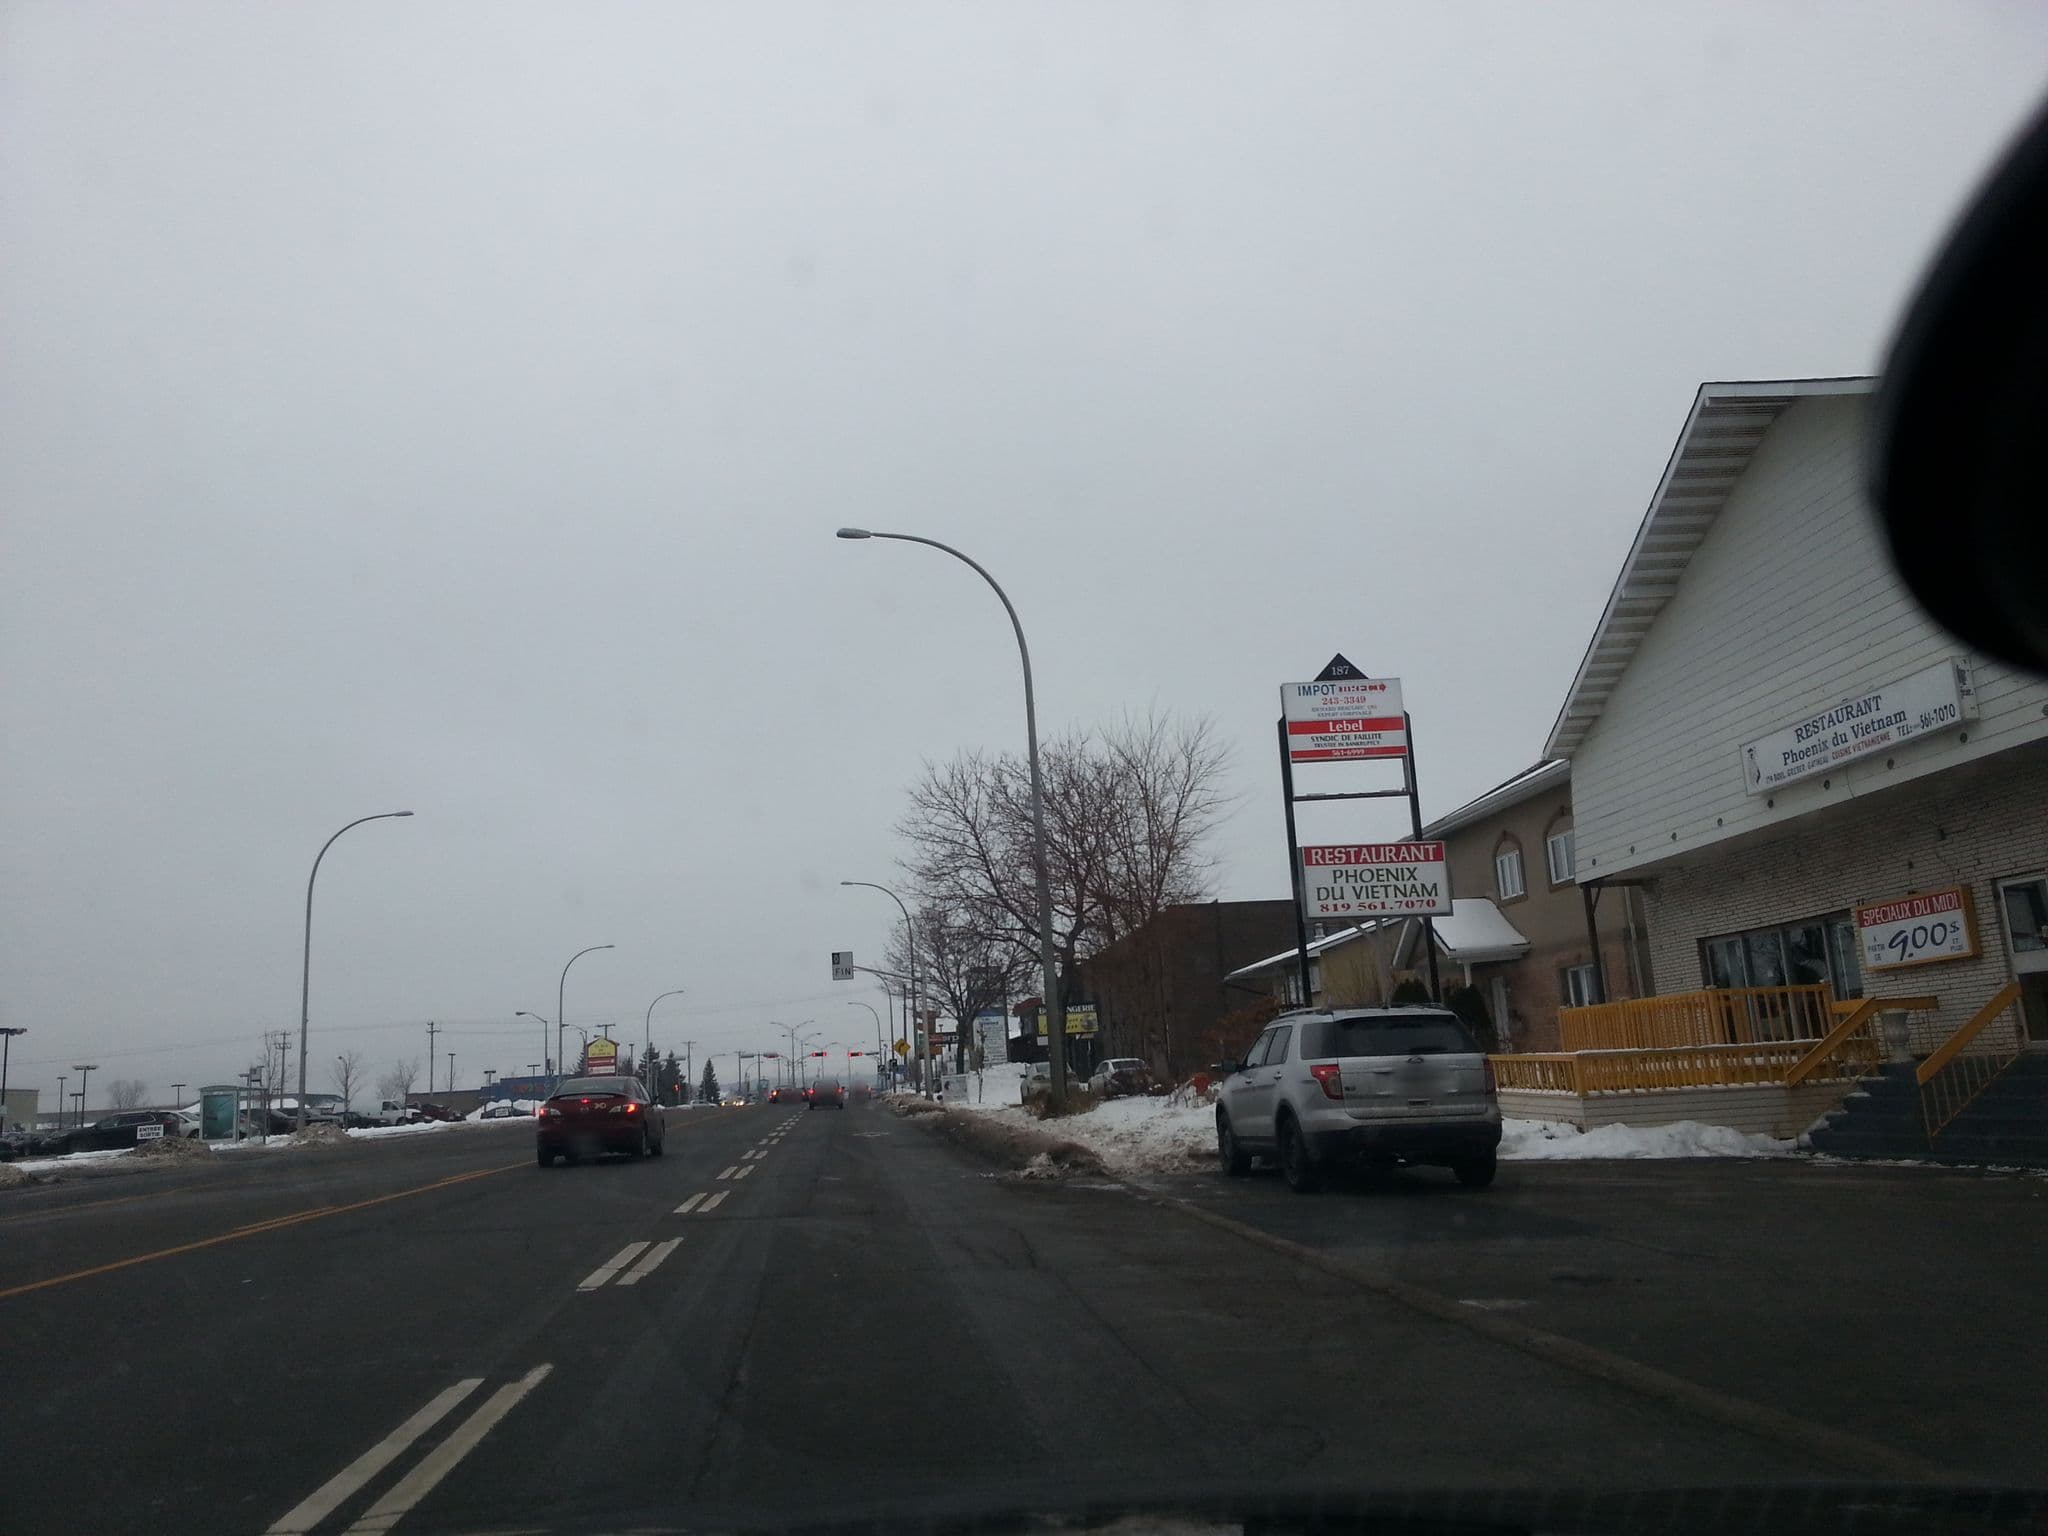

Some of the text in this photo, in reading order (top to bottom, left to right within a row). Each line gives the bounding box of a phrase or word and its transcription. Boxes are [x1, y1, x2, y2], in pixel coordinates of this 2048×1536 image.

[1332, 666, 1349, 675] 187
[1794, 694, 1882, 744] RESTAURANT
[1919, 702, 1957, 730] 561-7070
[1329, 720, 1363, 732] Lebel
[1310, 734, 1340, 742] SYNDIC
[1354, 732, 1382, 740] FAILLITE
[1782, 708, 1908, 767] Phoenix du Vietnam
[1311, 845, 1436, 864] RESTAURANT
[1332, 866, 1418, 884] PHOENIX
[1316, 882, 1439, 901] DU VIETNAM
[1319, 898, 1437, 913] 819 561.7070
[1913, 899, 1931, 917] DU
[1932, 892, 1959, 912] MIDI
[835, 967, 851, 977] FIN
